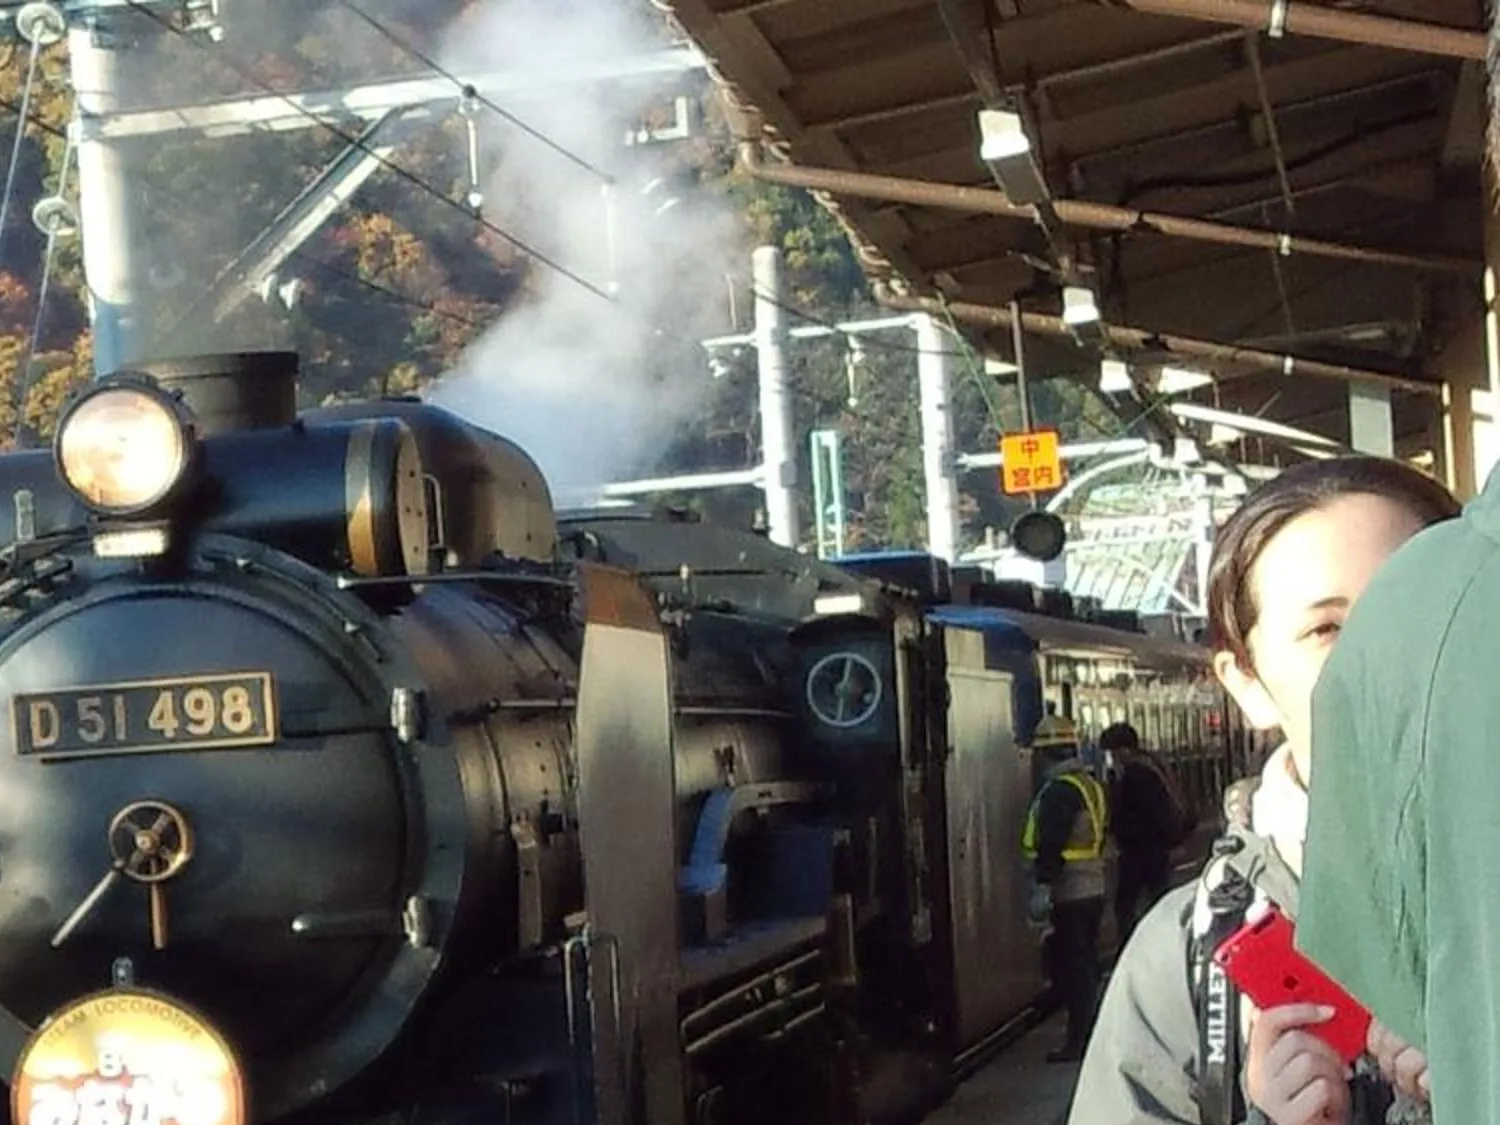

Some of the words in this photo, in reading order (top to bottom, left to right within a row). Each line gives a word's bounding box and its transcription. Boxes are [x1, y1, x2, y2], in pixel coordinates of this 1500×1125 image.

[1020, 438, 1041, 464] 中
[29, 700, 60, 748] D
[76, 694, 128, 743] 51
[147, 685, 254, 739] 498
[1207, 961, 1227, 1065] MILLET
